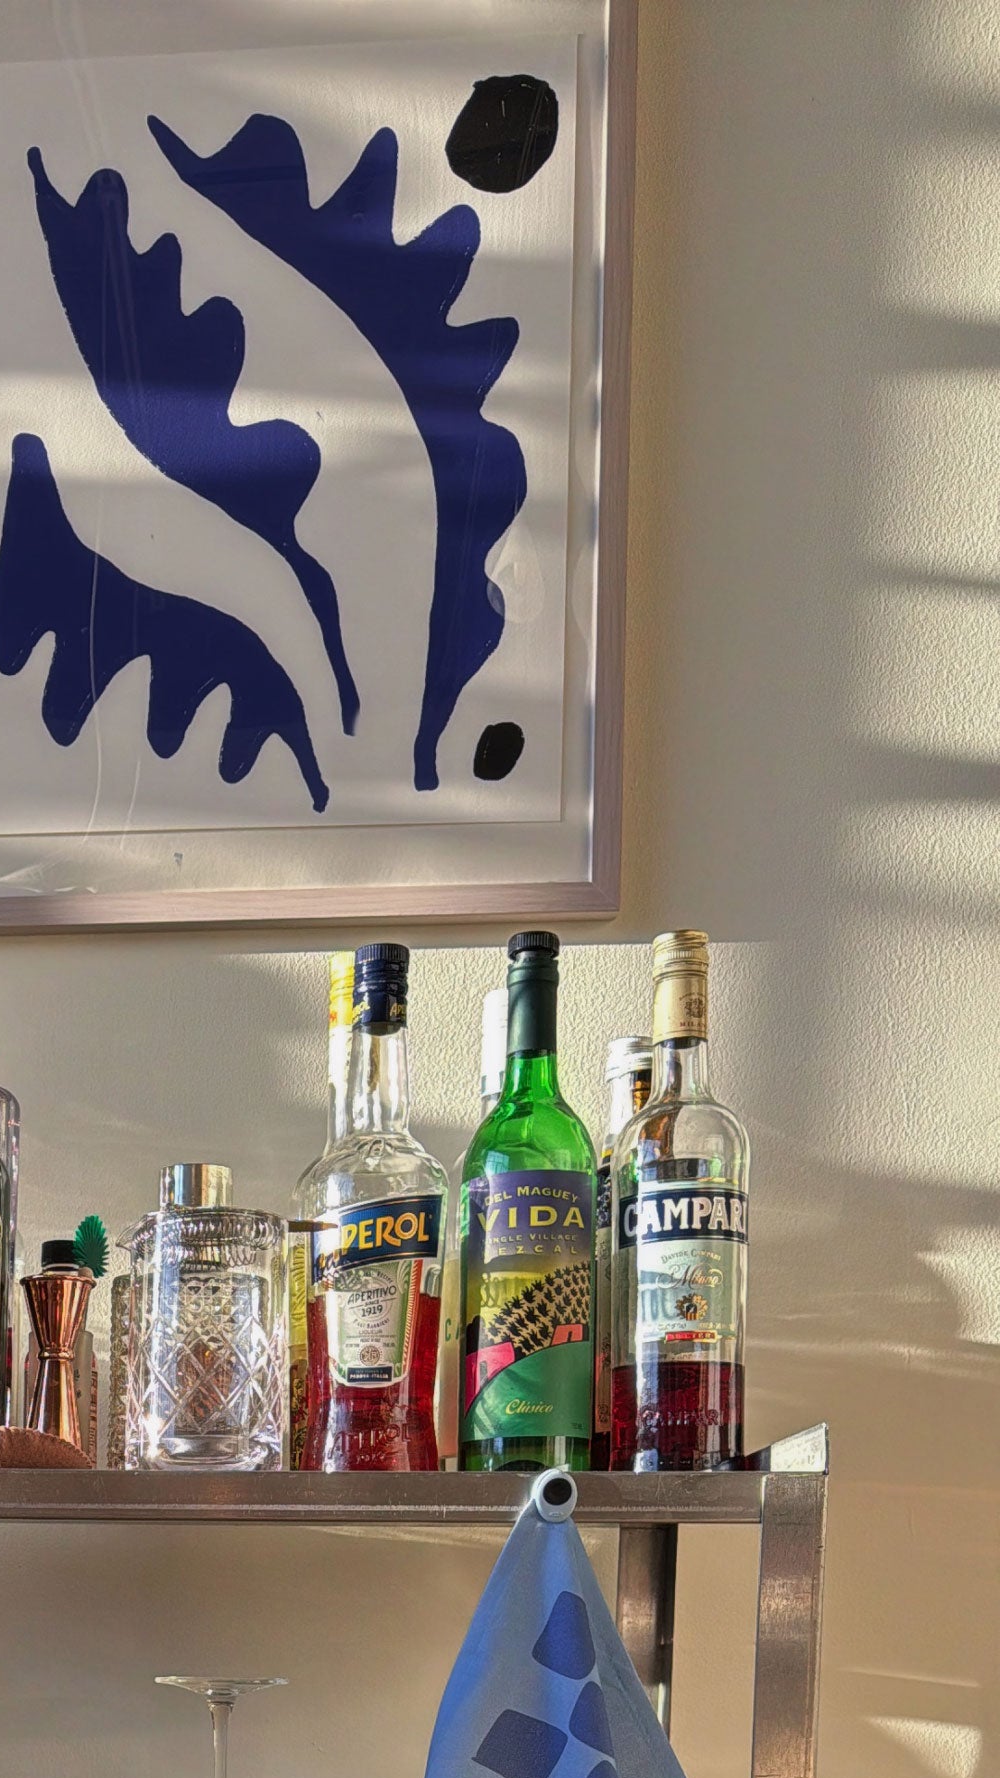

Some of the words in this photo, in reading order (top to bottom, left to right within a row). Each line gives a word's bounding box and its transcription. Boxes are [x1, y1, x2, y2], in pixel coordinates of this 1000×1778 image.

[484, 1191, 512, 1207] DEL
[517, 1185, 578, 1203] MAGUEY
[477, 1205, 585, 1232] VIDA
[319, 1212, 430, 1268] PEROL
[529, 1233, 578, 1242] VILLAGE
[490, 1245, 578, 1257] EZCAL
[347, 1285, 397, 1305] APERITIVO
[361, 1305, 383, 1317] 1919
